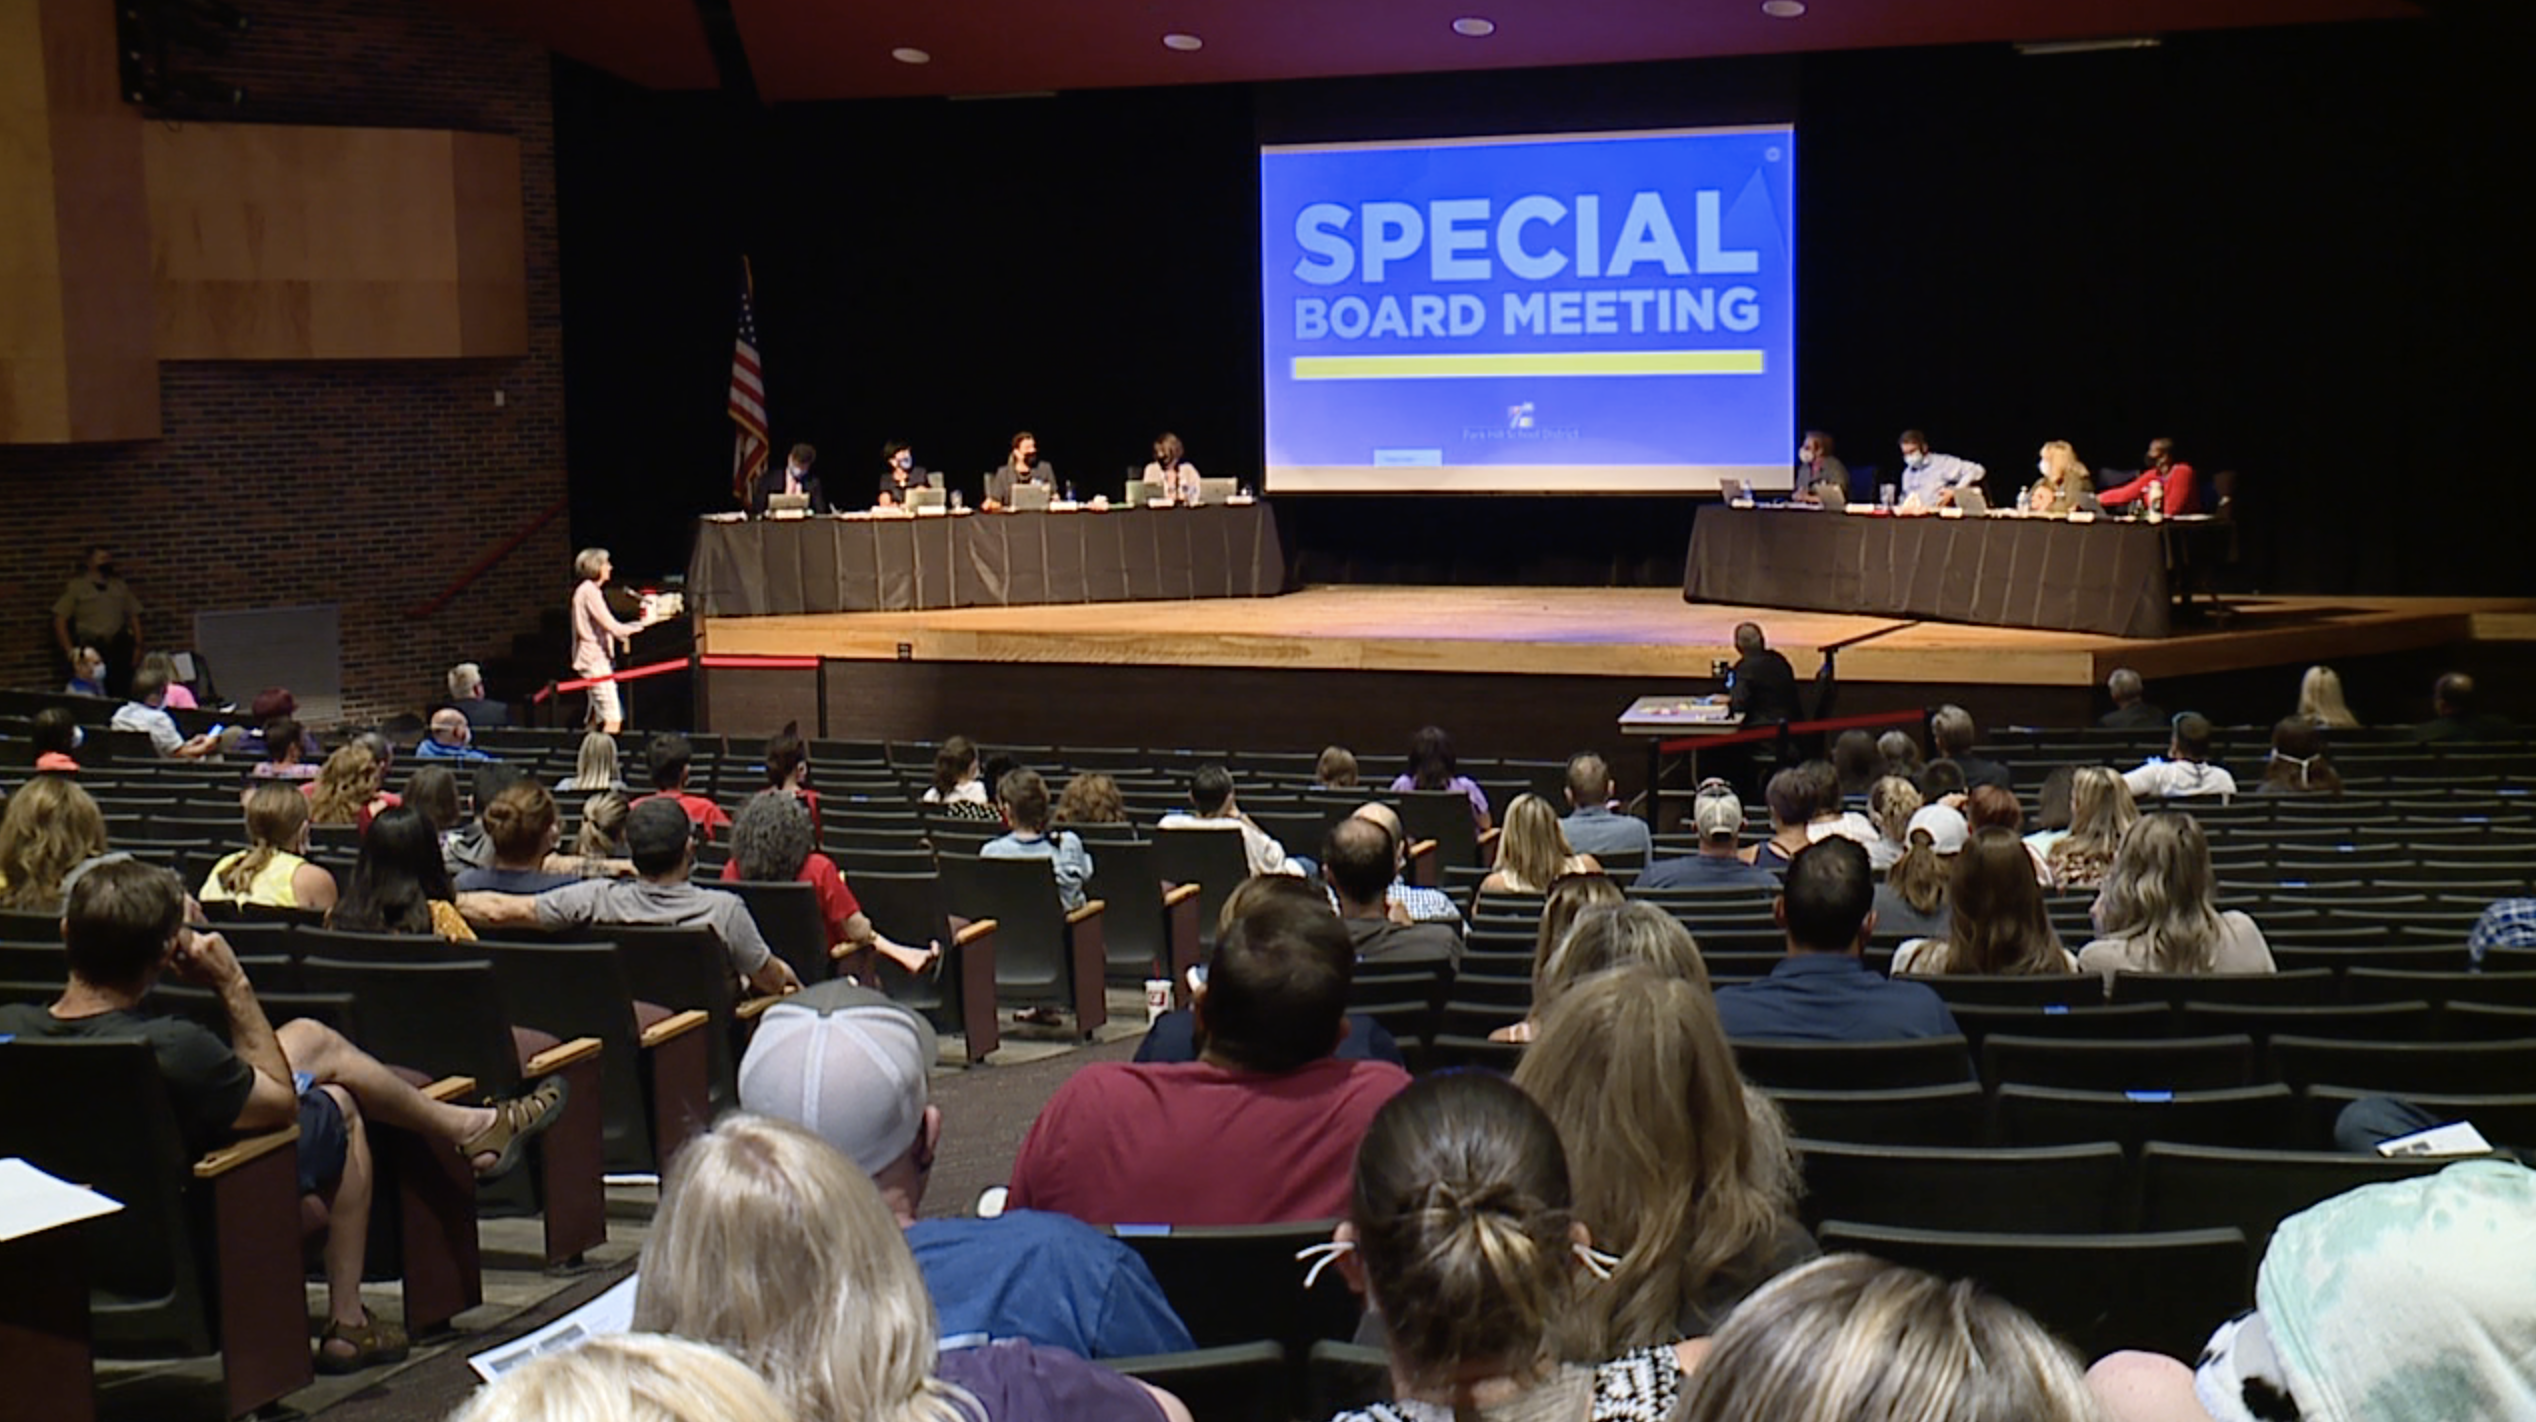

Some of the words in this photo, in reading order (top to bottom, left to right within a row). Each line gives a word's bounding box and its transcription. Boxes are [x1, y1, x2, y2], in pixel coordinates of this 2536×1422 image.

[1293, 190, 1759, 285] SPECIAL
[1295, 294, 1486, 340] BOARD
[1503, 287, 1760, 336] MEETING
